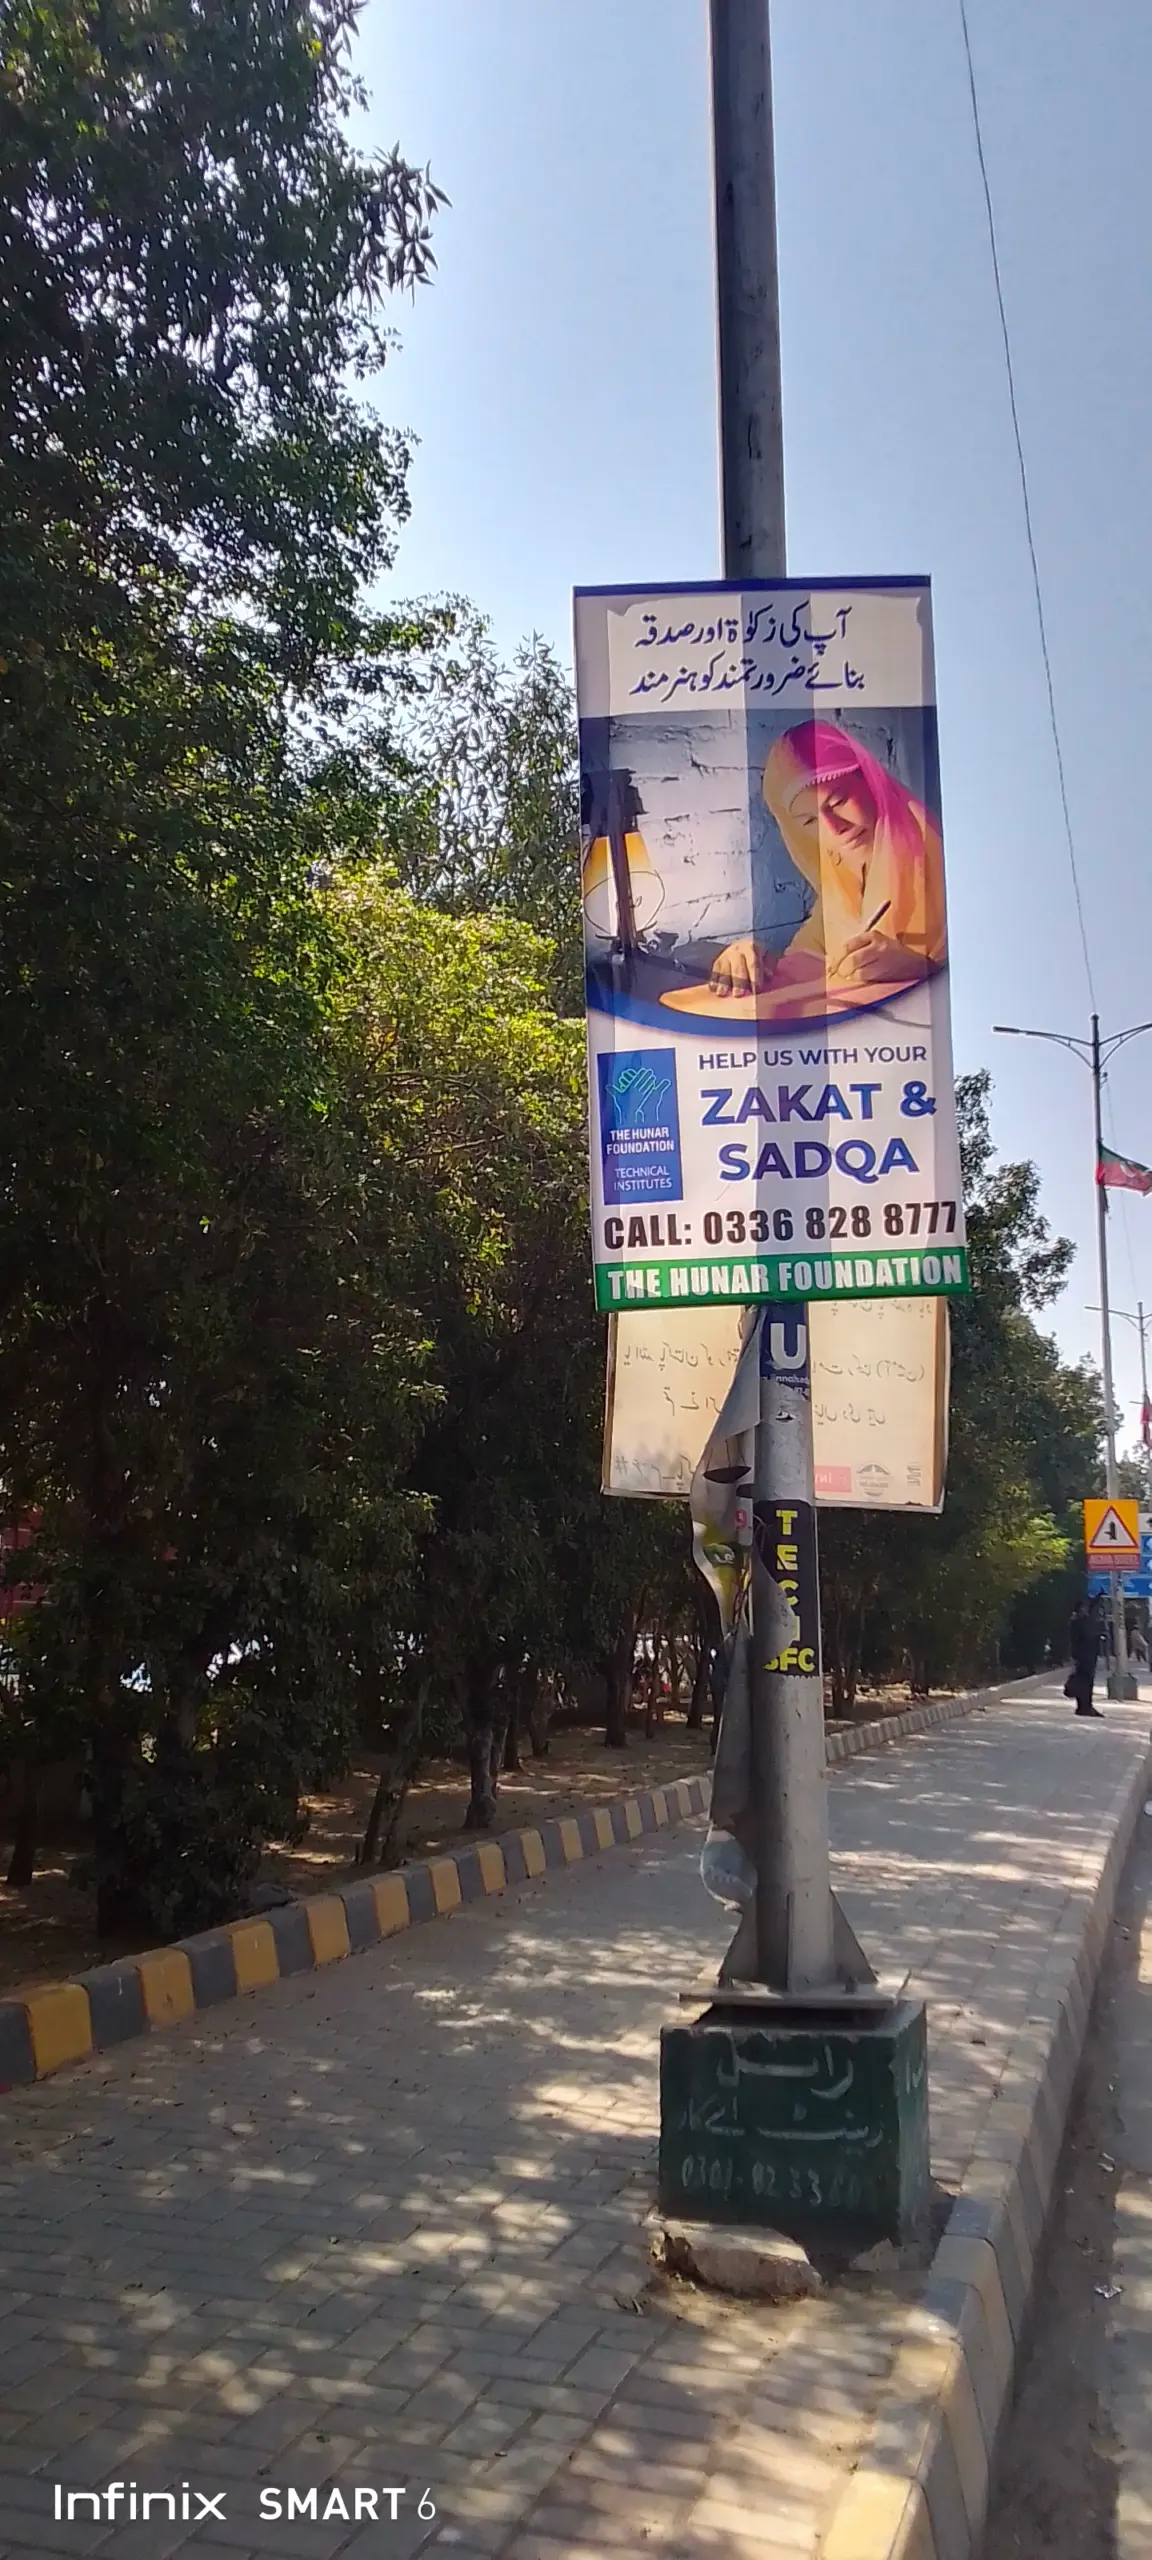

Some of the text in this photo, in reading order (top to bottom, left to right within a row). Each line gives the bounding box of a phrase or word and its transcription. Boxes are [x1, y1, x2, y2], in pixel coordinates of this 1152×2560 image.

[635, 614, 695, 648] صدقہ
[690, 617, 723, 644] اور
[780, 600, 810, 648] کی
[804, 606, 852, 656] آپ
[698, 650, 726, 691] کو
[699, 1046, 927, 1070] HELP US WITH YOUR
[700, 1080, 937, 1126] ZAKAT &
[606, 1140, 675, 1155] FOUNDATION
[610, 1127, 669, 1141] THE HUNAR
[614, 1166, 670, 1179] TECHNICAL
[719, 1138, 920, 1184] SADQA
[613, 1178, 673, 1191] INSTITUTES
[604, 1201, 956, 1250] CALL: 0336 828 8777
[607, 1255, 962, 1300] THE HUNAR FOUNDATION
